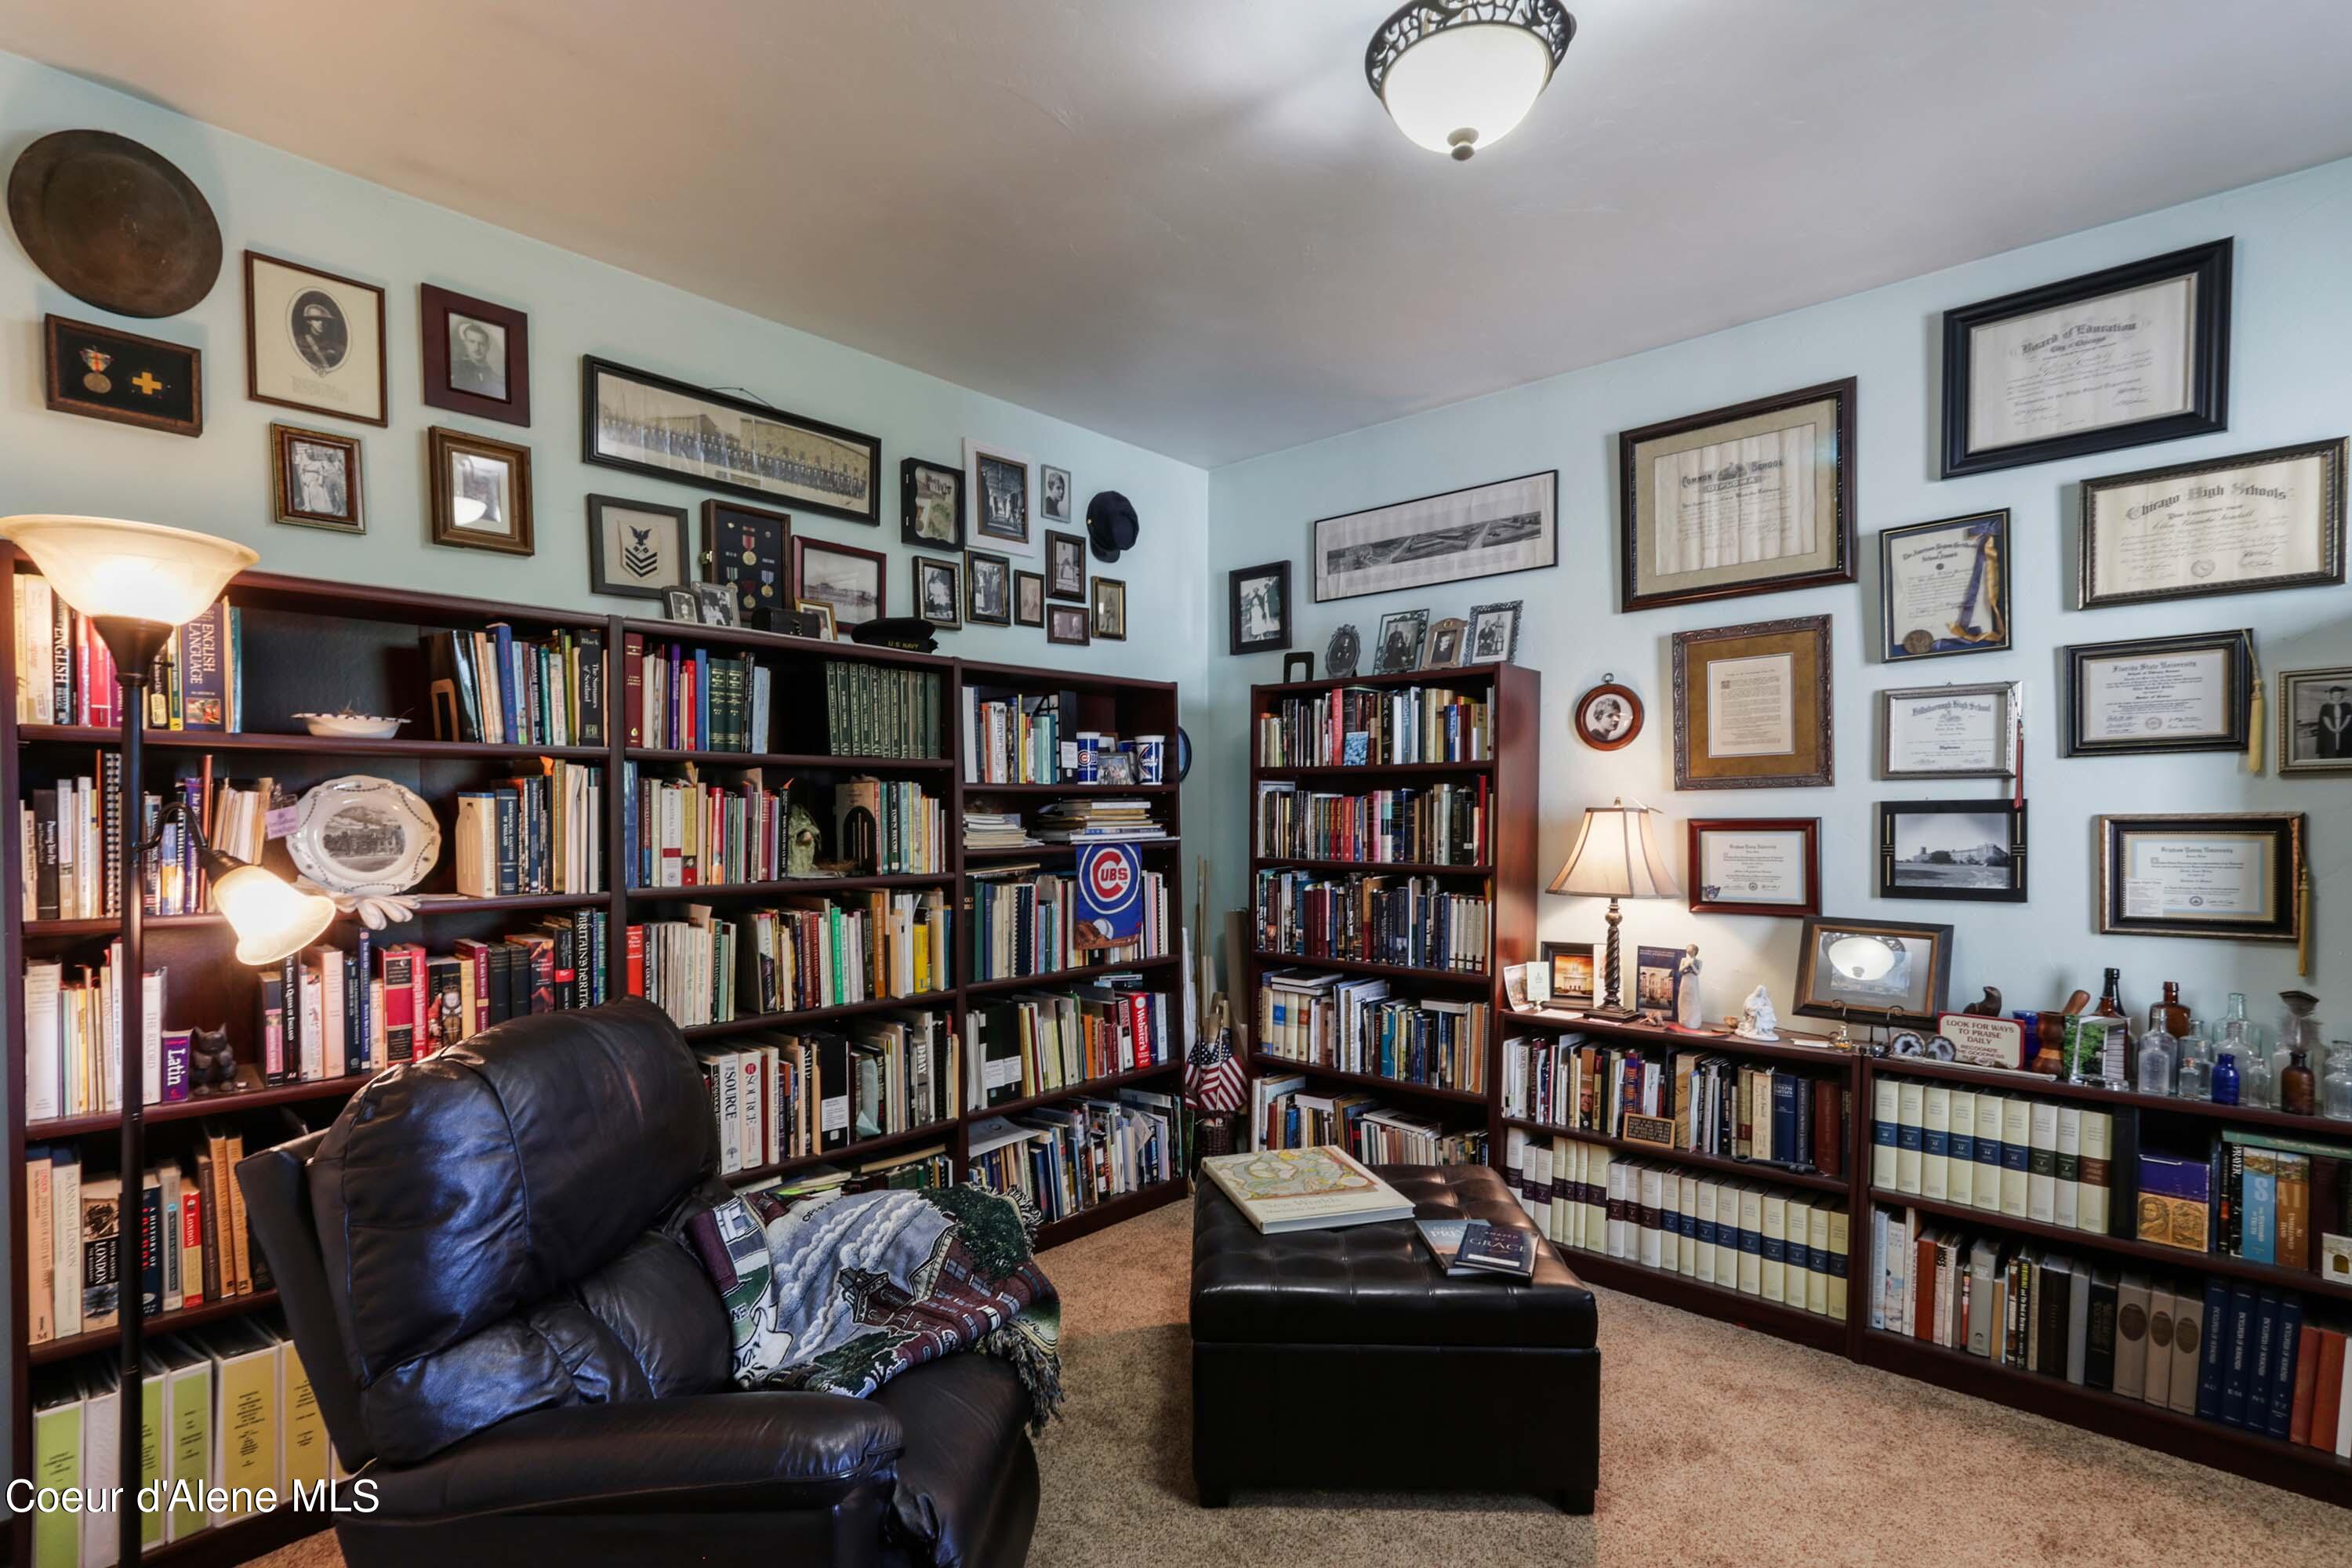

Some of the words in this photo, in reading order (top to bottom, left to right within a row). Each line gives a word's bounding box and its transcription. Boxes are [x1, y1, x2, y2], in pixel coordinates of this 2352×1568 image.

[2020, 334, 2058, 355] Board
[2077, 321, 2137, 336] Education
[1750, 459, 1784, 472] SCHOOL
[2125, 494, 2180, 521] Chicago
[2187, 485, 2225, 503] High
[2230, 481, 2287, 500] Schools
[54, 627, 69, 683] ENGLISH
[189, 622, 203, 684] LANGUAGE
[201, 623, 216, 672] ENGLISH
[581, 637, 599, 647] Black
[2112, 662, 2139, 673] Florida
[2140, 662, 2159, 672] State
[2160, 659, 2197, 670] University
[1969, 702, 1991, 713] School
[1094, 851, 1128, 898] CUBS
[285, 967, 296, 983] KINGS
[285, 989, 296, 1008] QUEENS
[287, 1017, 296, 1041] ENGLAND
[1135, 1008, 1148, 1051] Webster's
[1946, 1020, 1969, 1029] LOOK
[1991, 1025, 2014, 1033] WAYS
[1972, 1029, 2002, 1040] PRAISE
[146, 1032, 159, 1069] RECORD
[166, 1047, 187, 1087] Latin
[916, 1044, 926, 1074] D-DAY
[722, 1071, 737, 1121] SOURCE
[746, 1075, 758, 1126] SOURCE
[2232, 1145, 2243, 1177] PRAYER
[64, 1182, 78, 1218] ANNALS
[187, 1213, 198, 1247] LONDON
[1468, 1237, 1525, 1254] GRACE
[65, 1227, 78, 1268] LONDON
[94, 1241, 108, 1284] LONDON
[150, 1256, 157, 1268] OF
